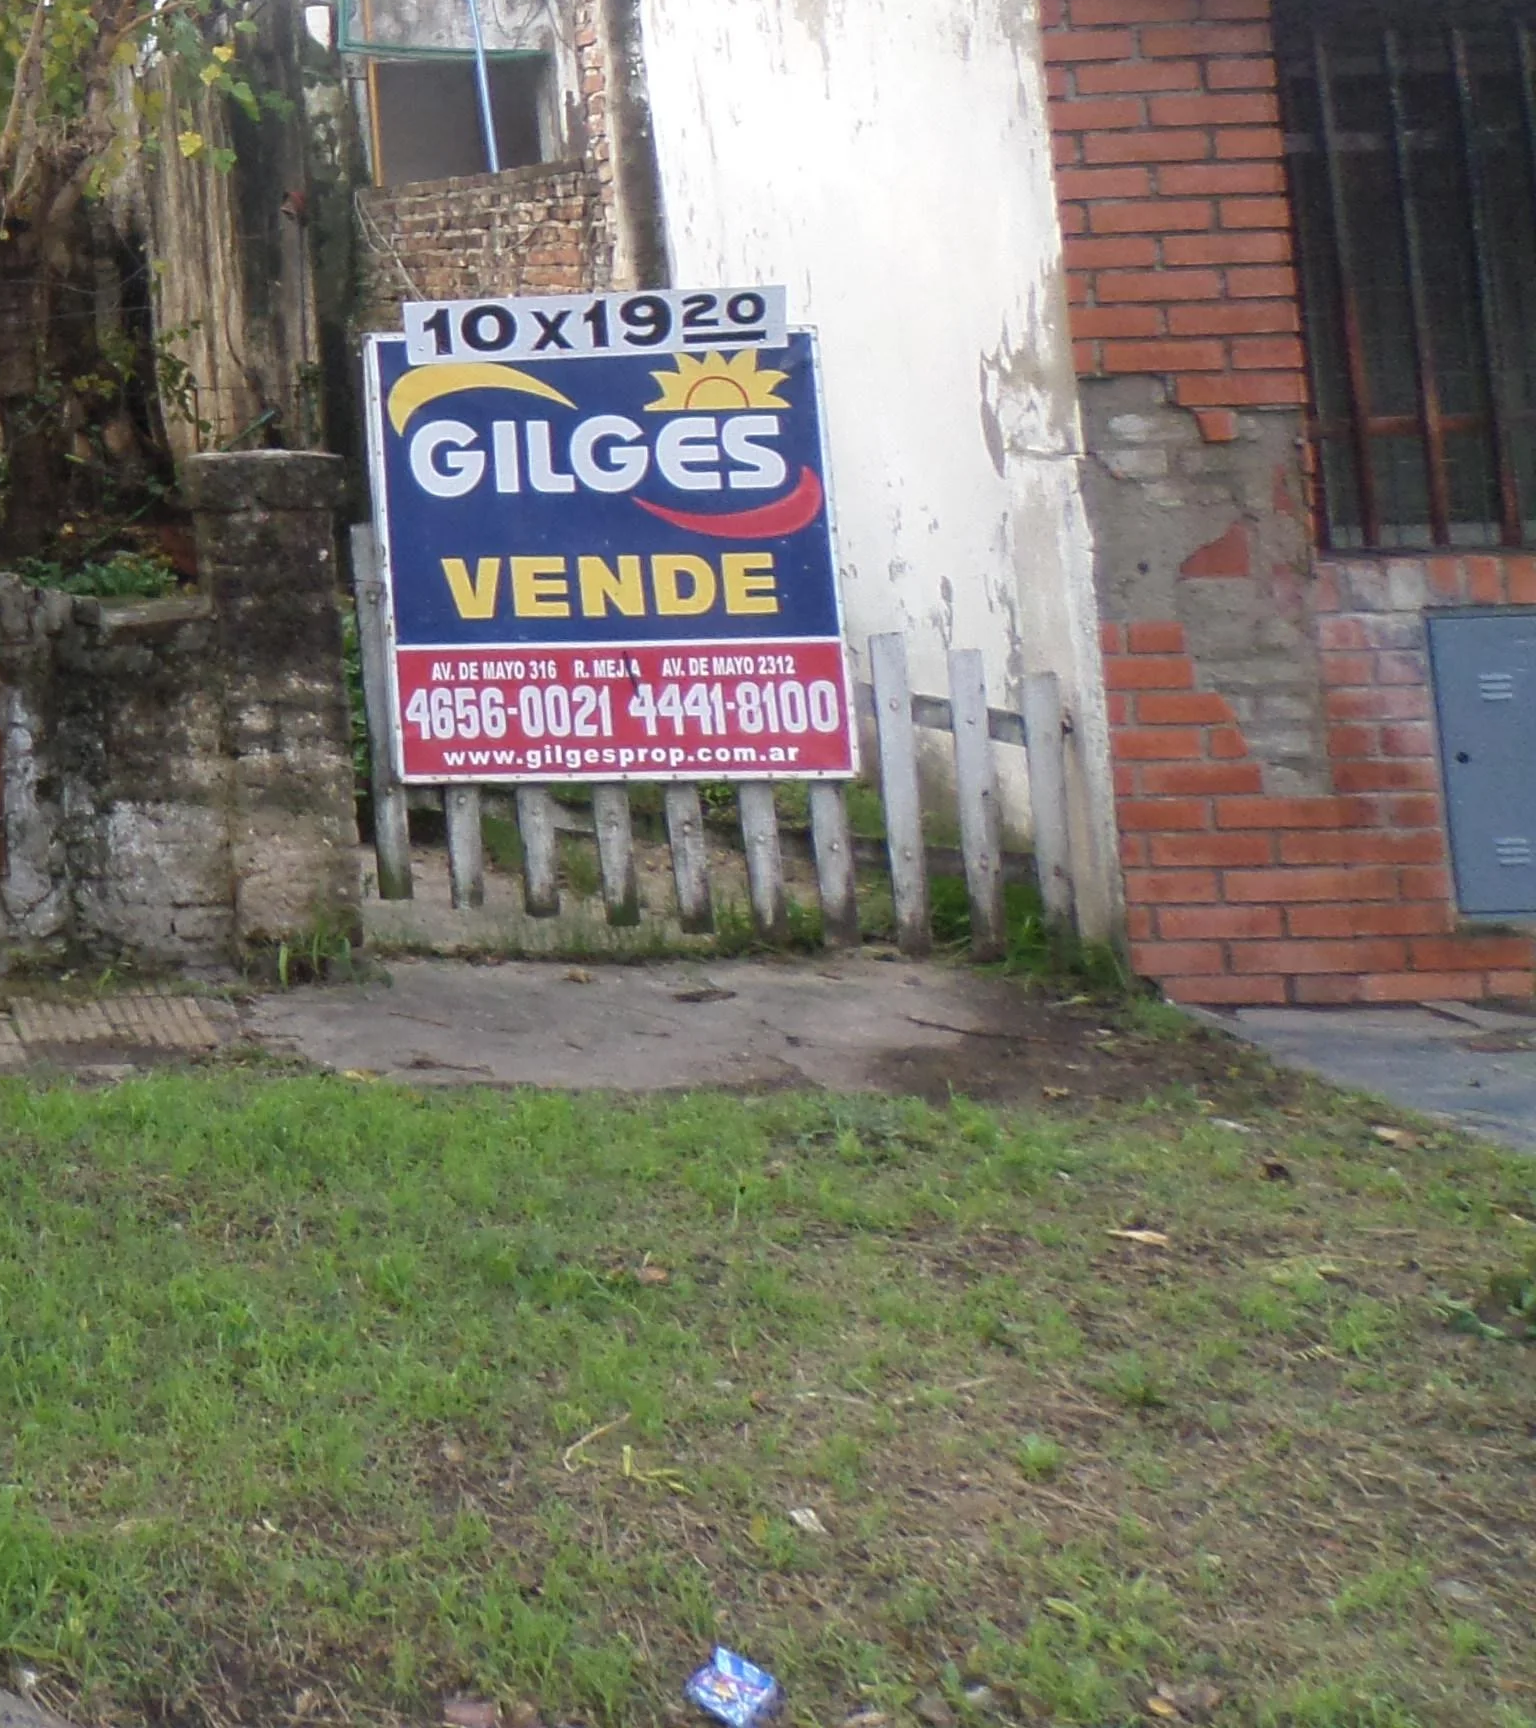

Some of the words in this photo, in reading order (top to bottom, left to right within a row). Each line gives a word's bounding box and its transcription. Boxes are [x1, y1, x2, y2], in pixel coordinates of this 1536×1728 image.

[409, 415, 786, 497] GILGES
[441, 553, 778, 619] VENDE
[432, 662, 455, 680] AV.
[458, 661, 479, 680] DE
[483, 660, 525, 680] MAYO
[529, 659, 557, 679] 316
[574, 660, 589, 678] R.
[662, 658, 685, 677] AV.
[688, 657, 709, 676] DE
[713, 656, 754, 675] MAYO
[758, 655, 796, 674] 2312
[406, 684, 613, 740] 4656-0021
[629, 680, 840, 736] 4441-8100
[443, 744, 800, 769] www.gilgesprop.com.ar
